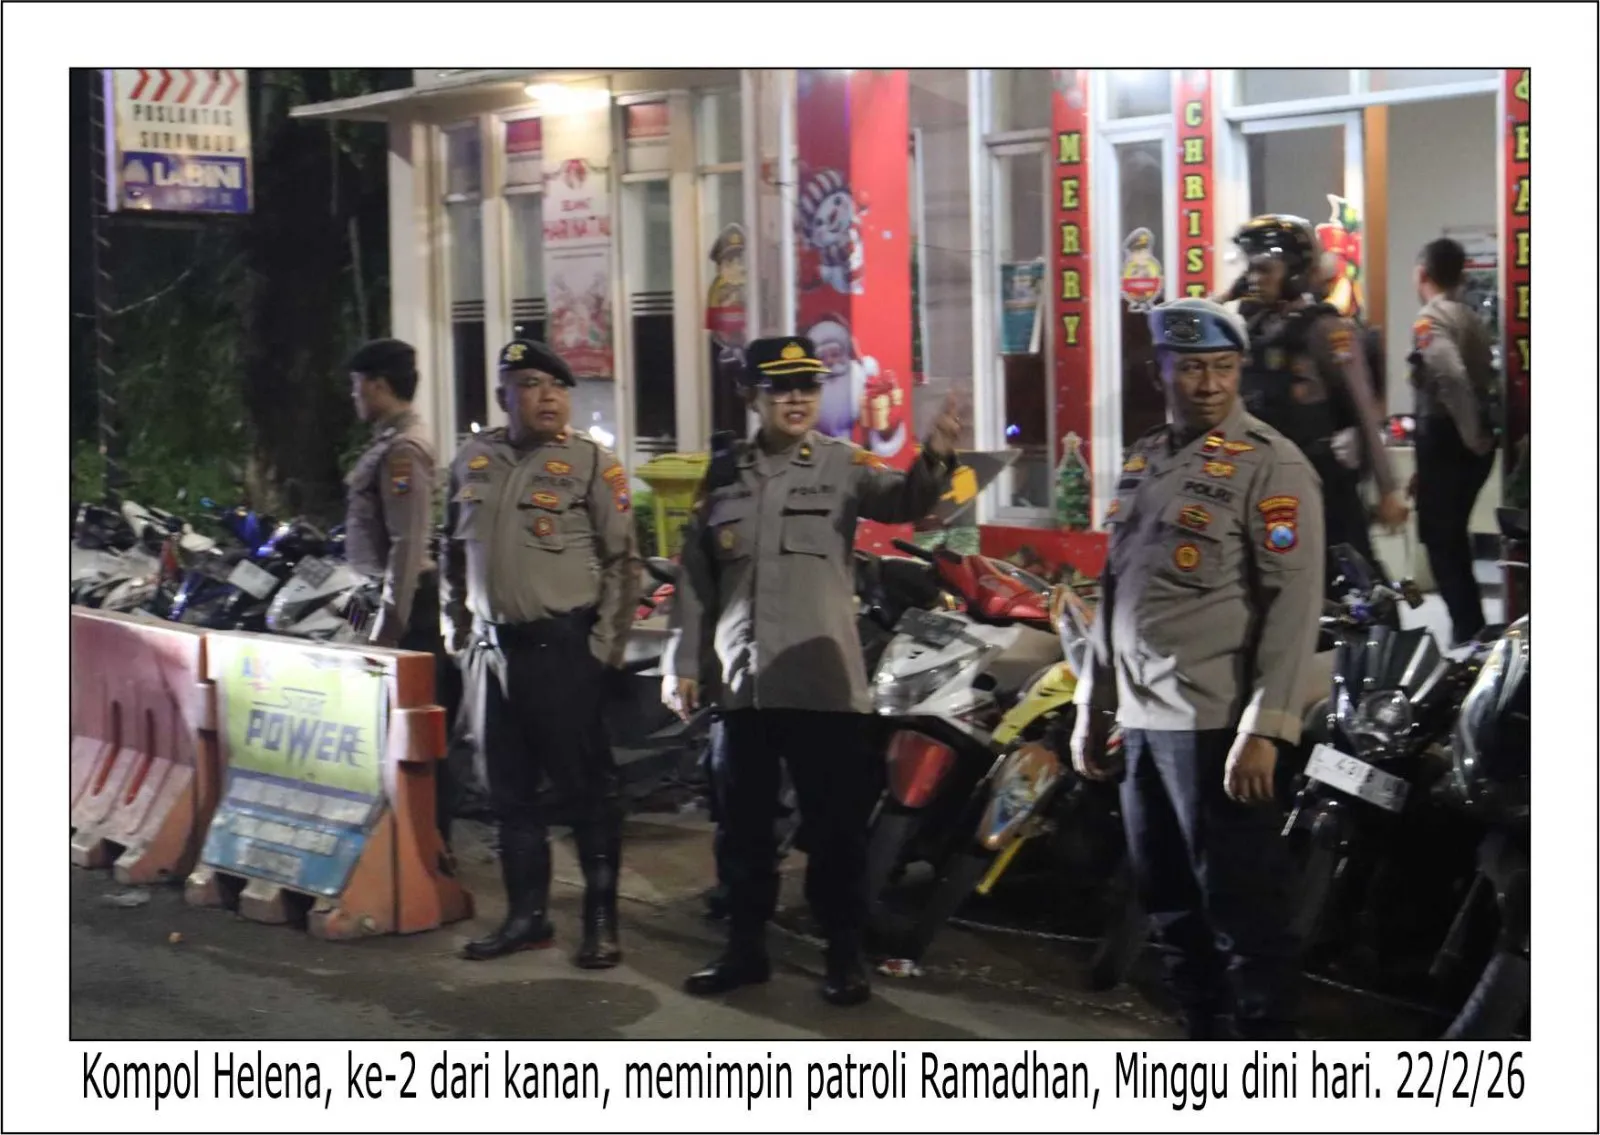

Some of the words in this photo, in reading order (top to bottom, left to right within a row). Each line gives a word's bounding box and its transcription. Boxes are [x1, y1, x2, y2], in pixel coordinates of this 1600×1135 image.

[1058, 132, 1082, 345] MERRY
[788, 484, 836, 496] POLRI
[1183, 480, 1235, 503] POLRI
[245, 708, 366, 768] POWER
